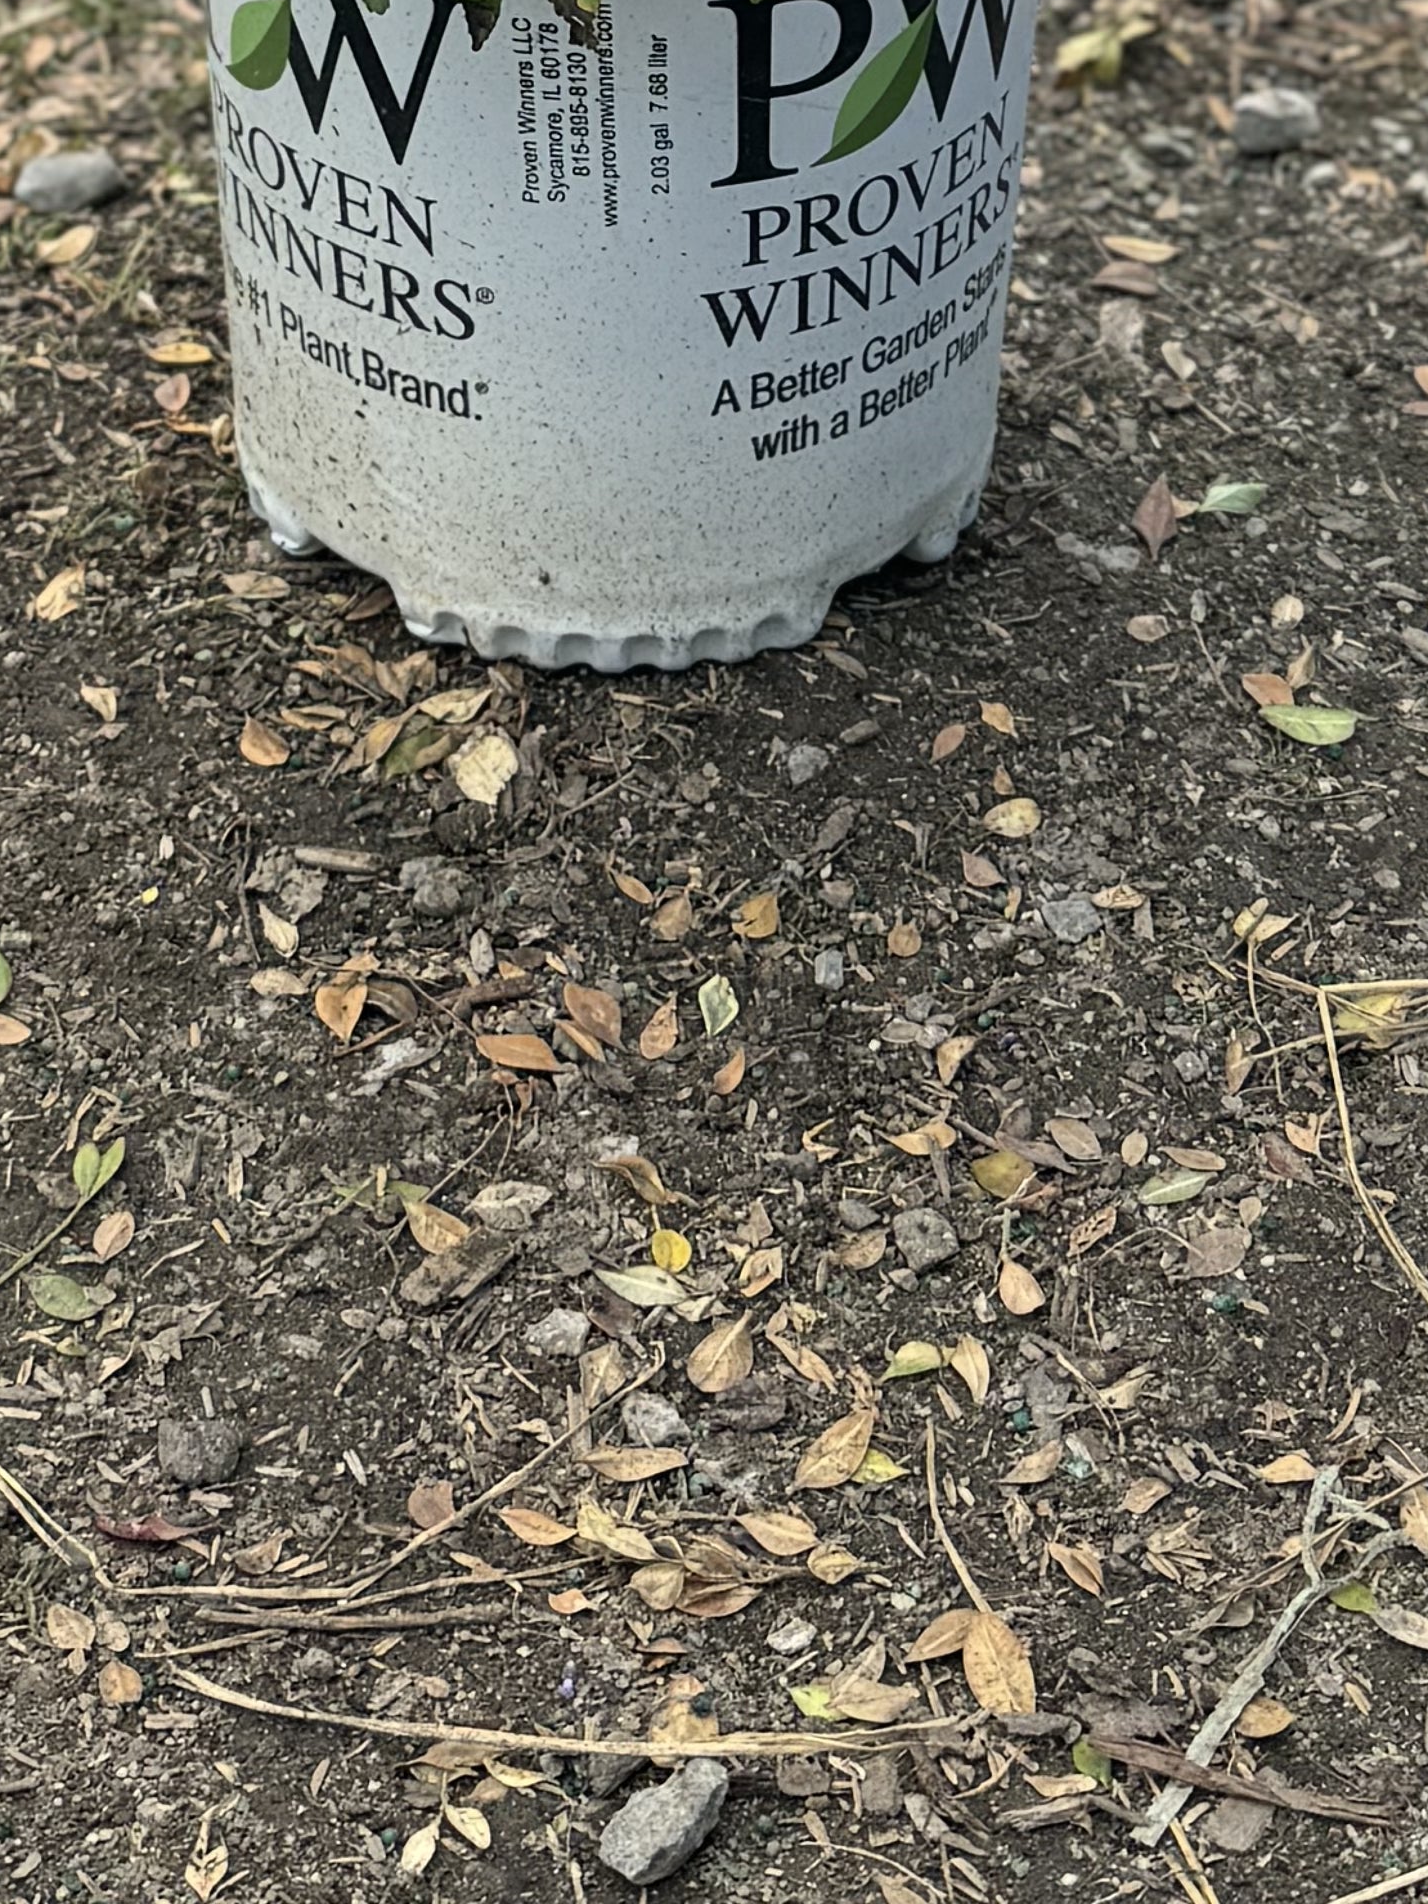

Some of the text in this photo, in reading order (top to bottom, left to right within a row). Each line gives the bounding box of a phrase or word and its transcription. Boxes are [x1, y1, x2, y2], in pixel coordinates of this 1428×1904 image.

[511, 16, 540, 204] Proven Winners LLC
[543, 84, 561, 101] IL
[566, 51, 591, 177] 815-895-8130
[595, 3, 620, 228] www.provenwinners.com
[647, 34, 674, 195] 2.03 gal 7.68 liter
[547, 107, 570, 203] Sycamore,
[741, 90, 1009, 267] PROVEN
[280, 302, 355, 377] Plant
[710, 378, 741, 417] A
[750, 355, 854, 410] Better
[861, 295, 957, 374] Garden
[750, 413, 820, 462] with
[829, 409, 850, 440] a
[859, 360, 940, 429] Better
